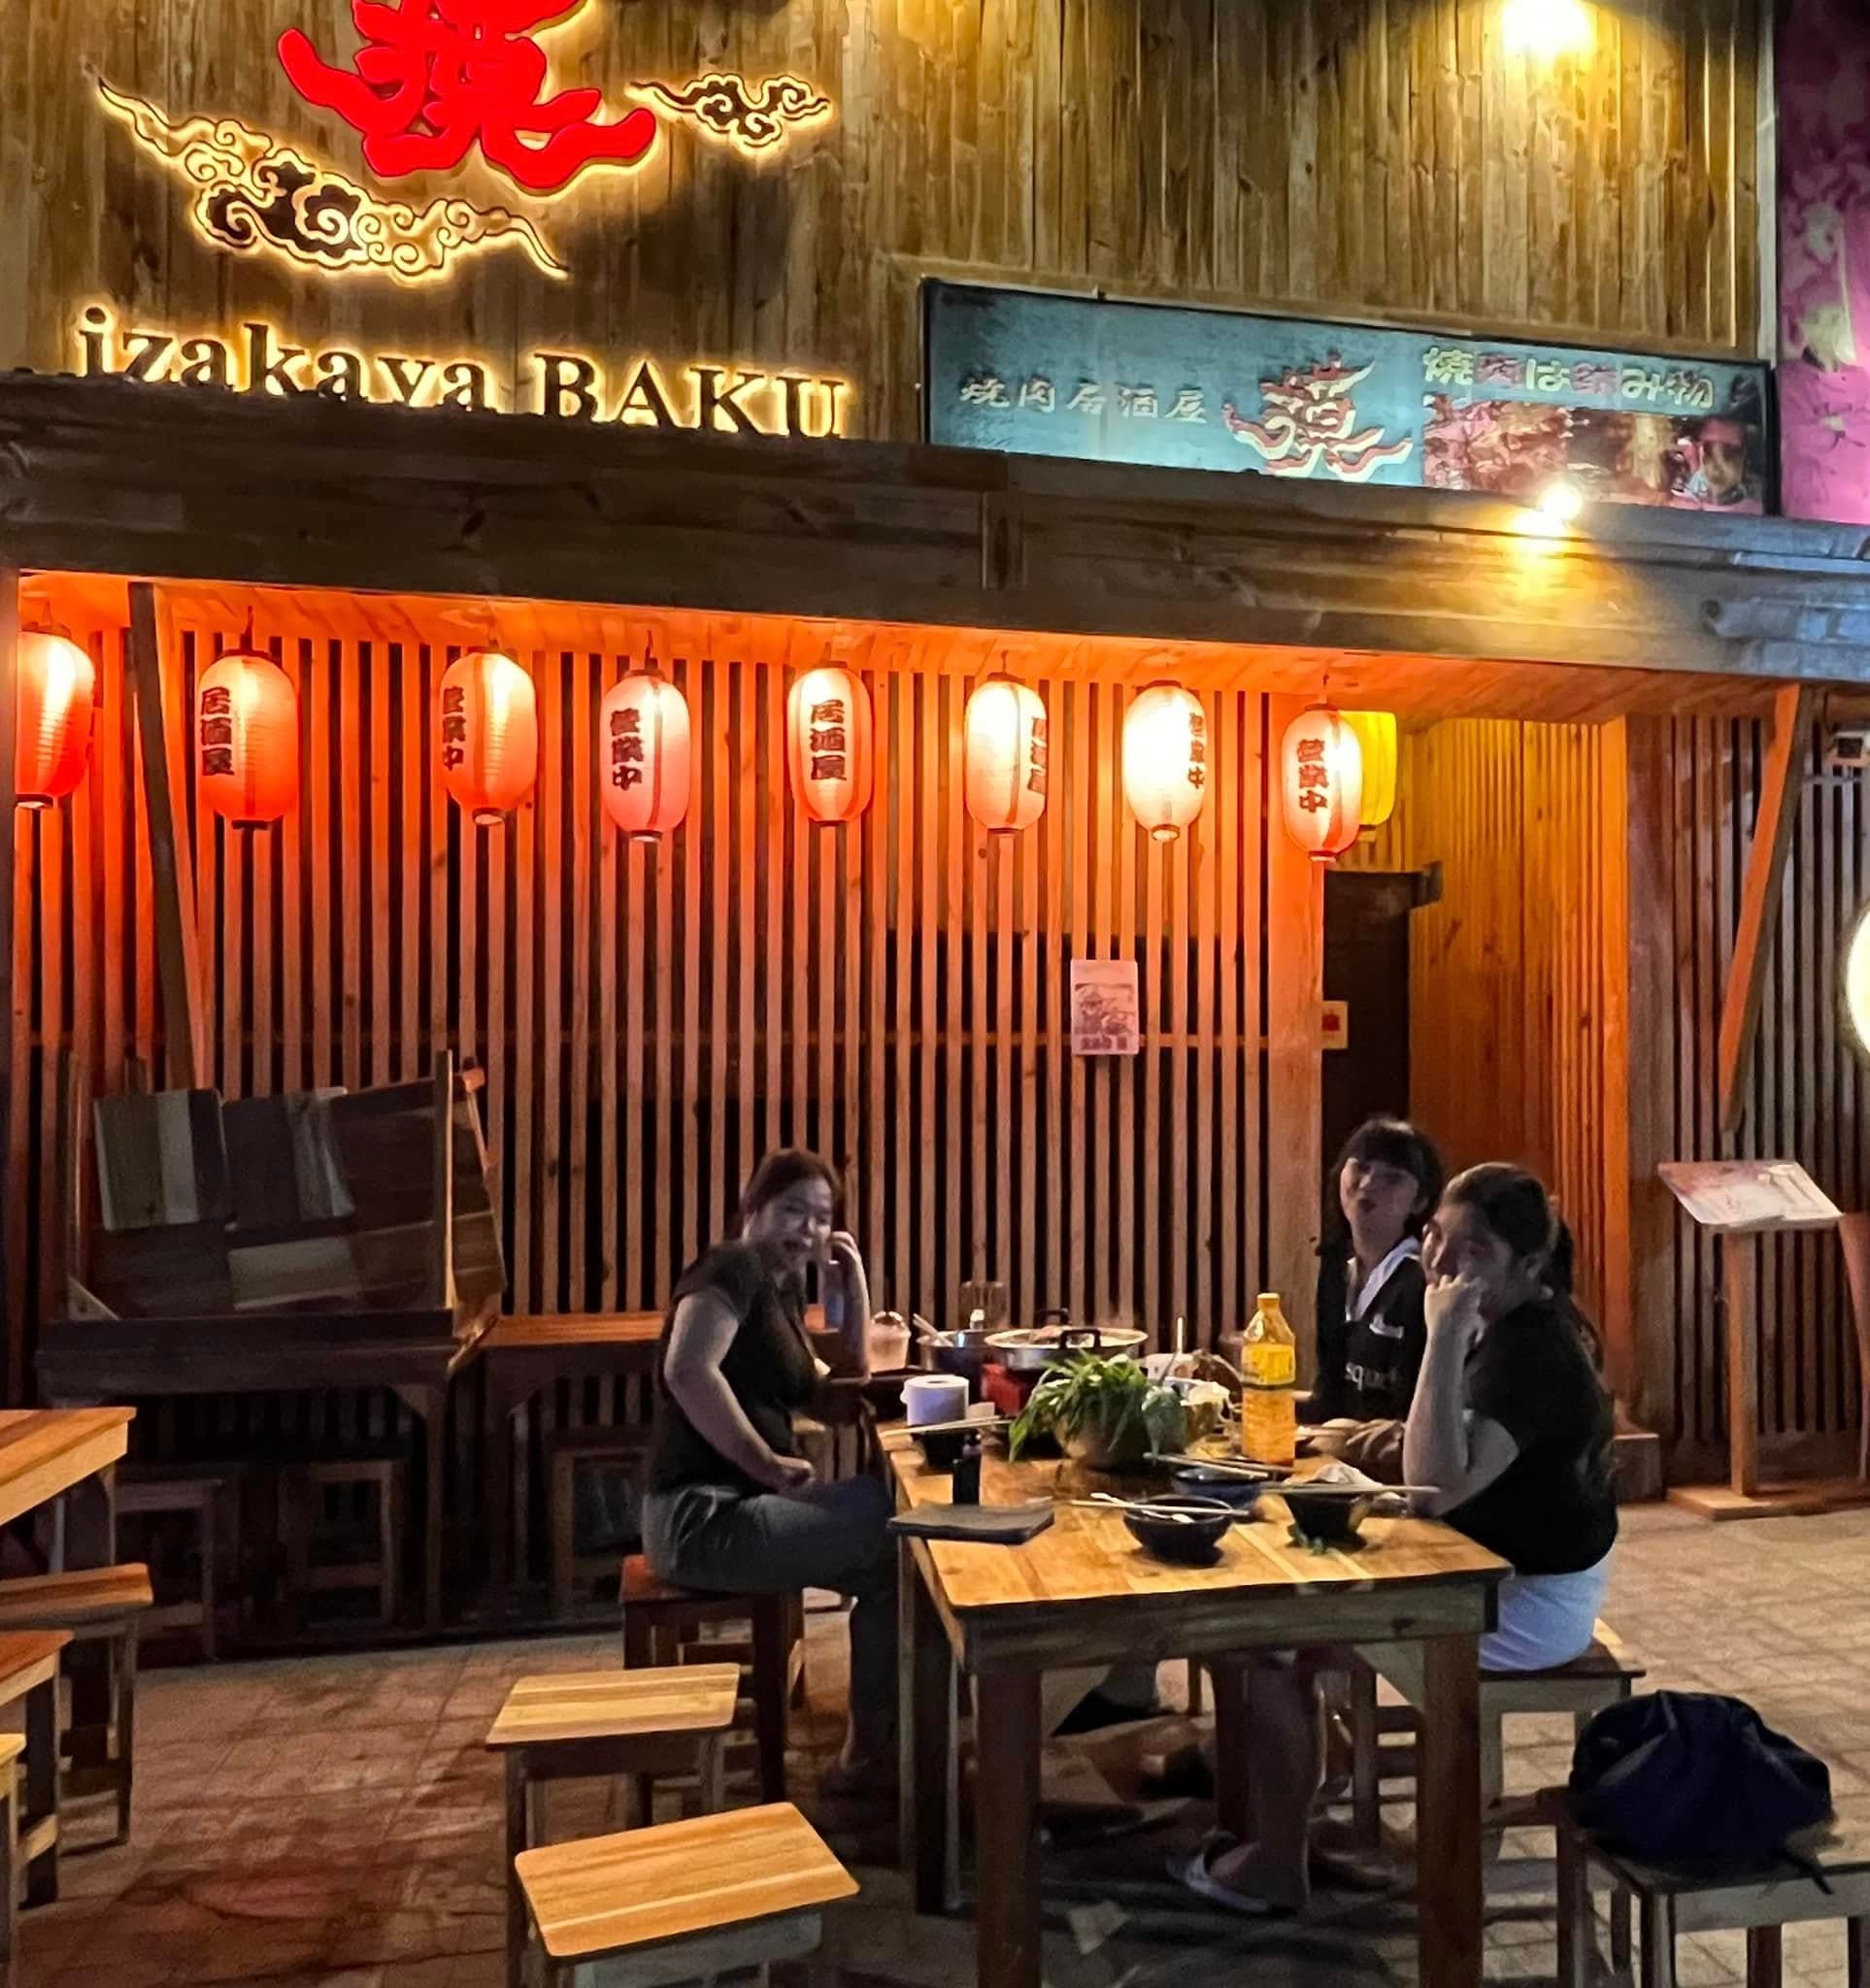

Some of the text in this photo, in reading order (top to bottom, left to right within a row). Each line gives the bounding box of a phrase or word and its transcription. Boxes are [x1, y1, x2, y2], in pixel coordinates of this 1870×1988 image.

[534, 352, 846, 439] BAKU
[201, 686, 235, 777] 居酒屋
[809, 698, 848, 782] 居酒屋
